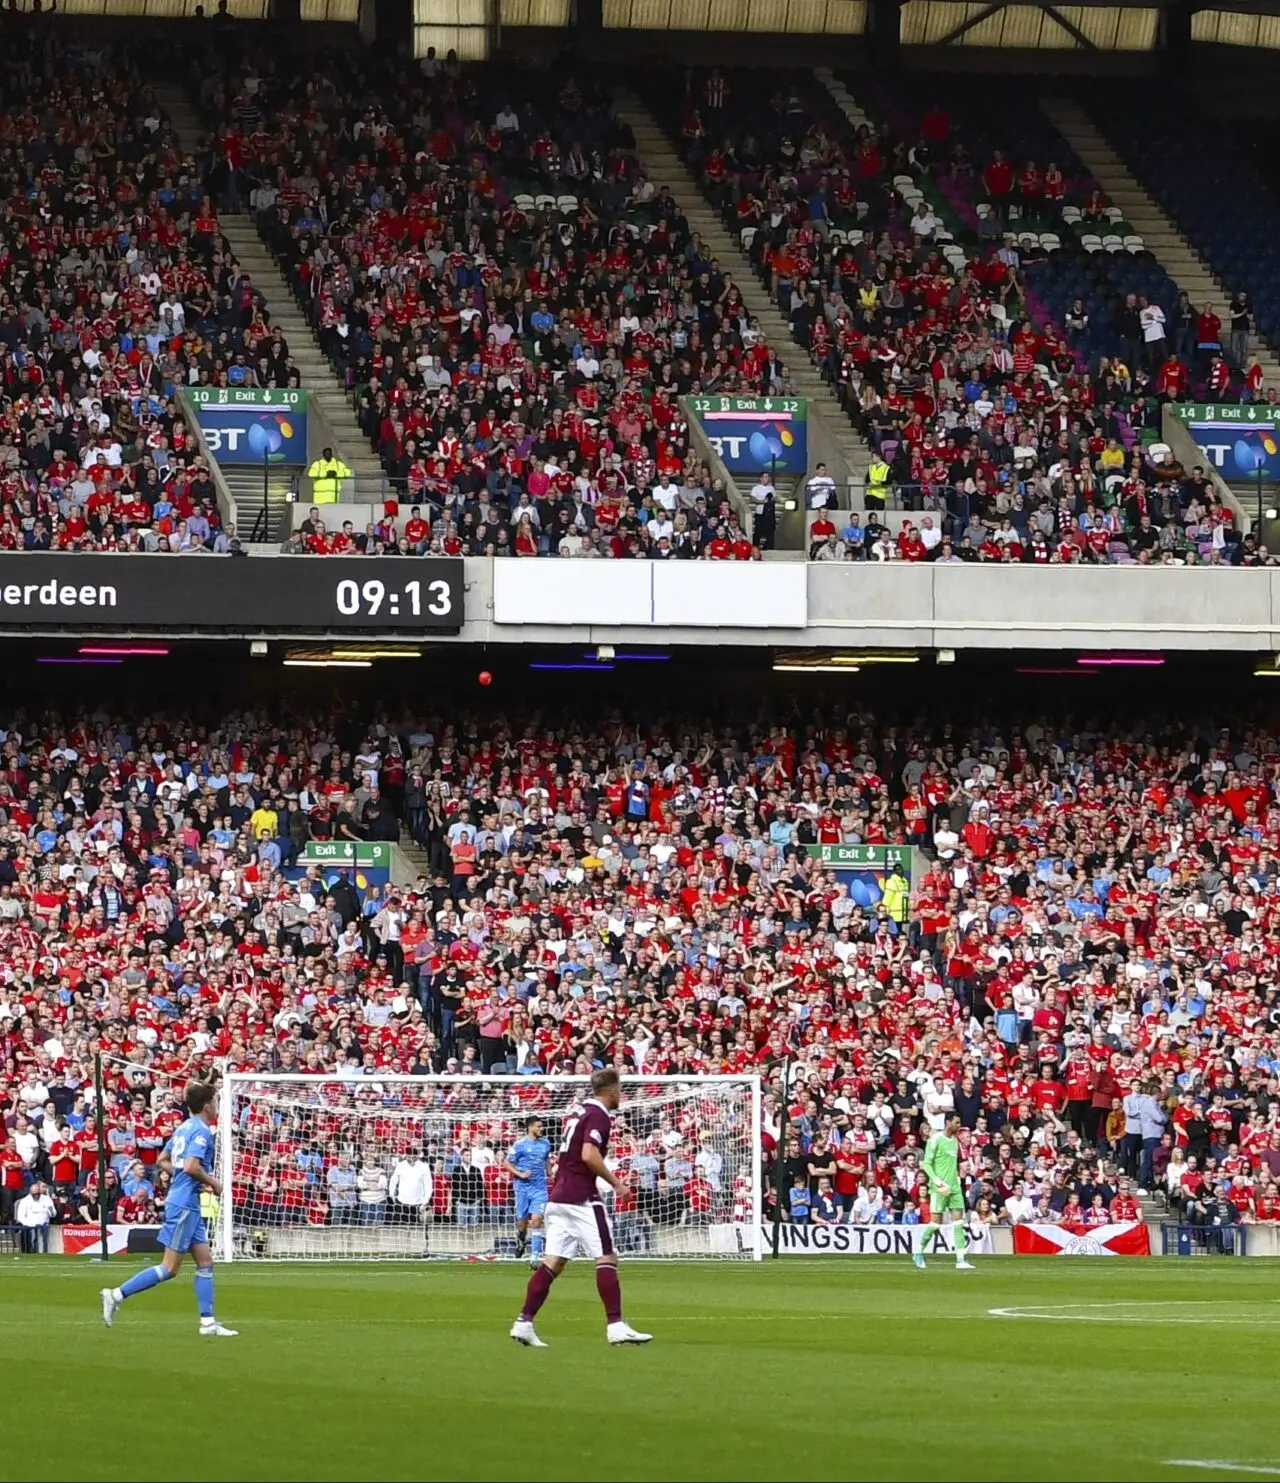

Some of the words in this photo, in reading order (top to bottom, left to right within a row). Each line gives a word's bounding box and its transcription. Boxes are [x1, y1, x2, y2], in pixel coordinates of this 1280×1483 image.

[193, 391, 210, 402] 10
[235, 391, 257, 402] Exit
[282, 393, 299, 404] 10
[695, 400, 711, 411] 12
[736, 400, 758, 411] Exit
[783, 401, 799, 413] 12
[1180, 407, 1196, 418] 14
[1221, 408, 1242, 419] Exit
[1265, 409, 1280, 420] 14
[202, 428, 246, 451] BT
[336, 579, 452, 616] 09:13
[315, 844, 337, 856] Exit
[373, 846, 381, 858] 9
[838, 848, 860, 860] Exit
[886, 849, 902, 861] 11
[63, 1228, 102, 1237] EDINBURG
